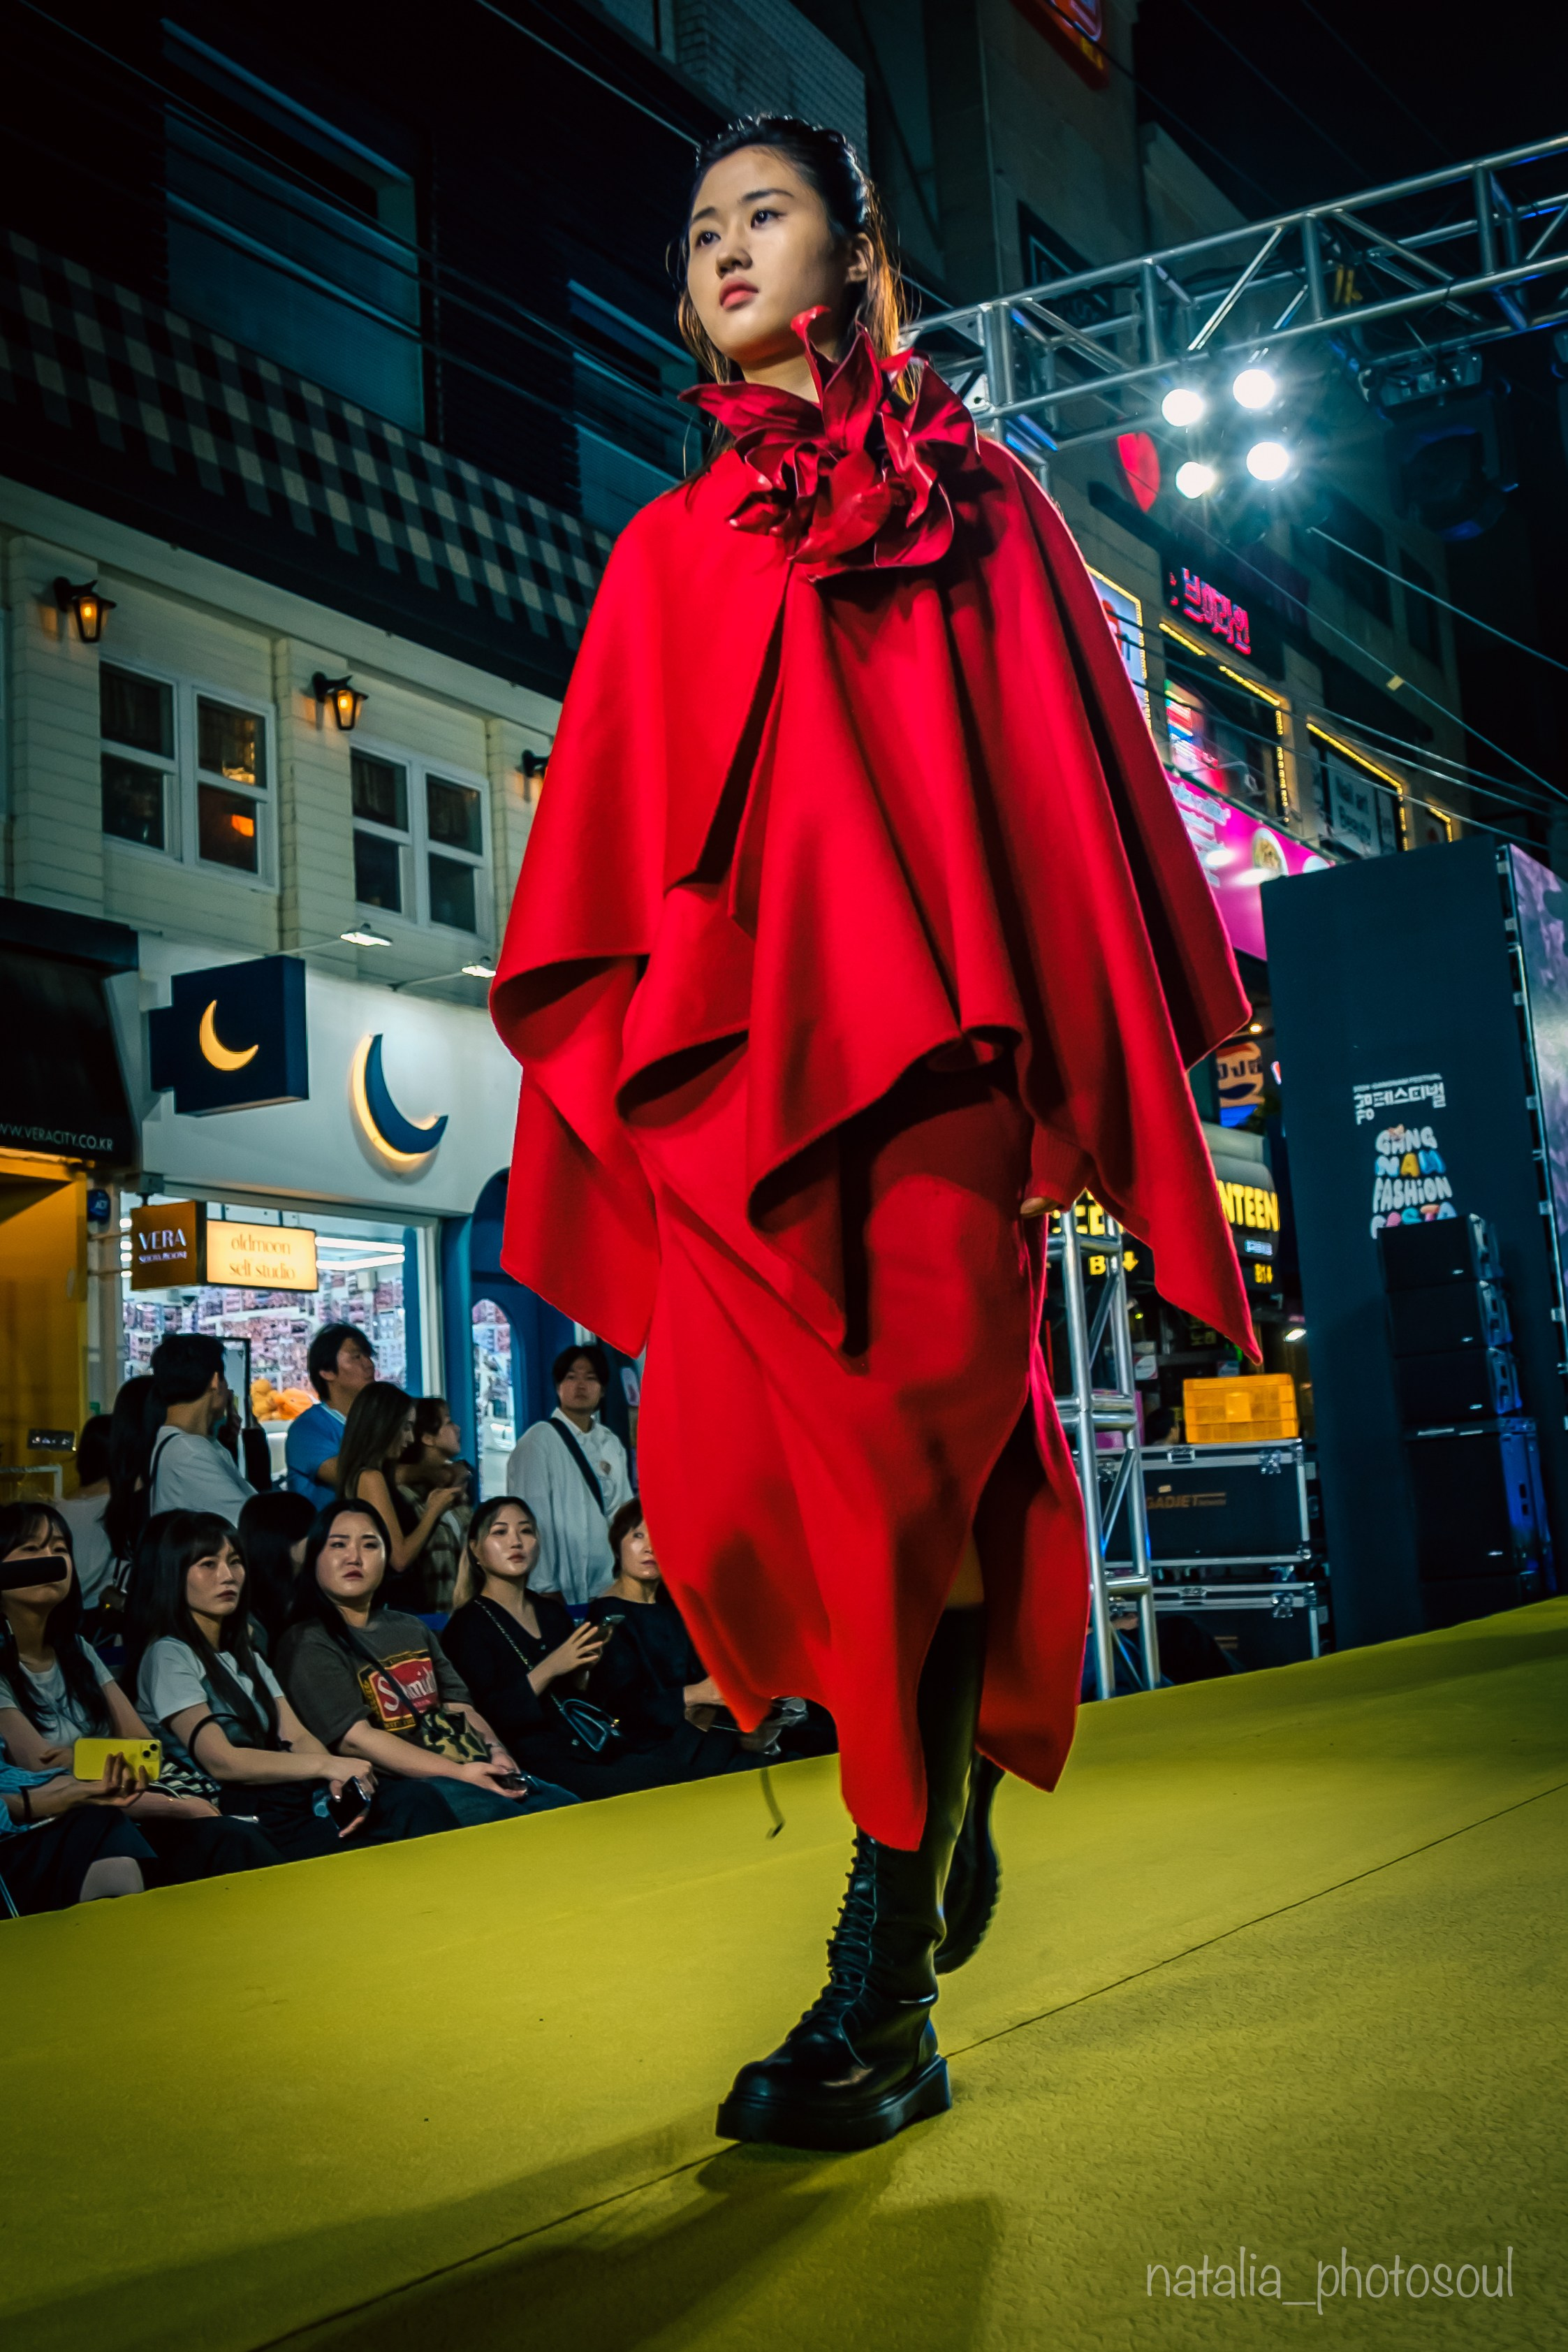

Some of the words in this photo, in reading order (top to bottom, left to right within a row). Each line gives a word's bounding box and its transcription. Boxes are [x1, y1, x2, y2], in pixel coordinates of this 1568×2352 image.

[1375, 1125, 1438, 1156] GANG
[1375, 1150, 1446, 1178] NAM
[139, 1228, 186, 1250] VERA
[231, 1234, 291, 1255] oldmoon
[256, 1264, 296, 1280] studio
